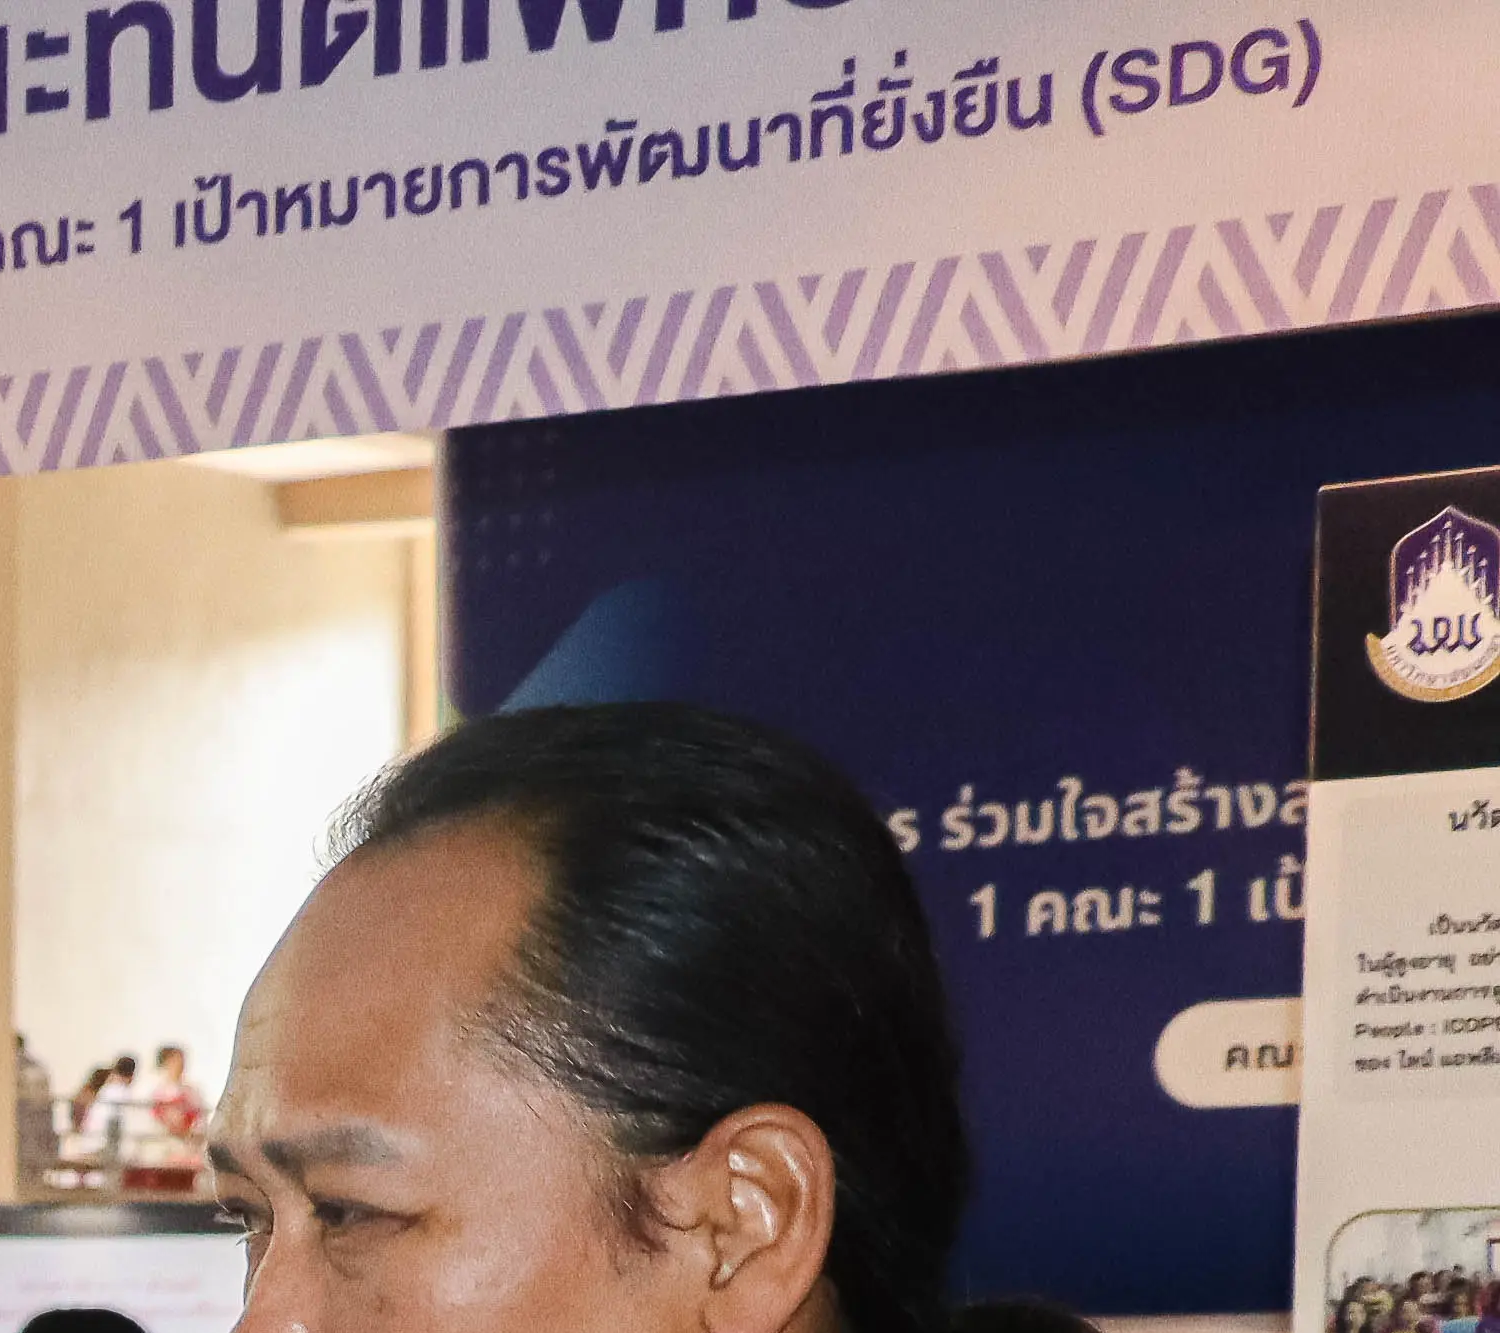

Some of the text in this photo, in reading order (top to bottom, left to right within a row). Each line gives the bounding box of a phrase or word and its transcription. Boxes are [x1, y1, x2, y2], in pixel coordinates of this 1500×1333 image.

[119, 200, 143, 253] 1
[174, 50, 1053, 248] เป้าหมายการพัฒนาที่ยั่งยืน
[1082, 19, 1323, 136] (SDG)
[968, 881, 996, 940] 1
[1025, 885, 1164, 937] คณะ
[1185, 868, 1218, 926] 1
